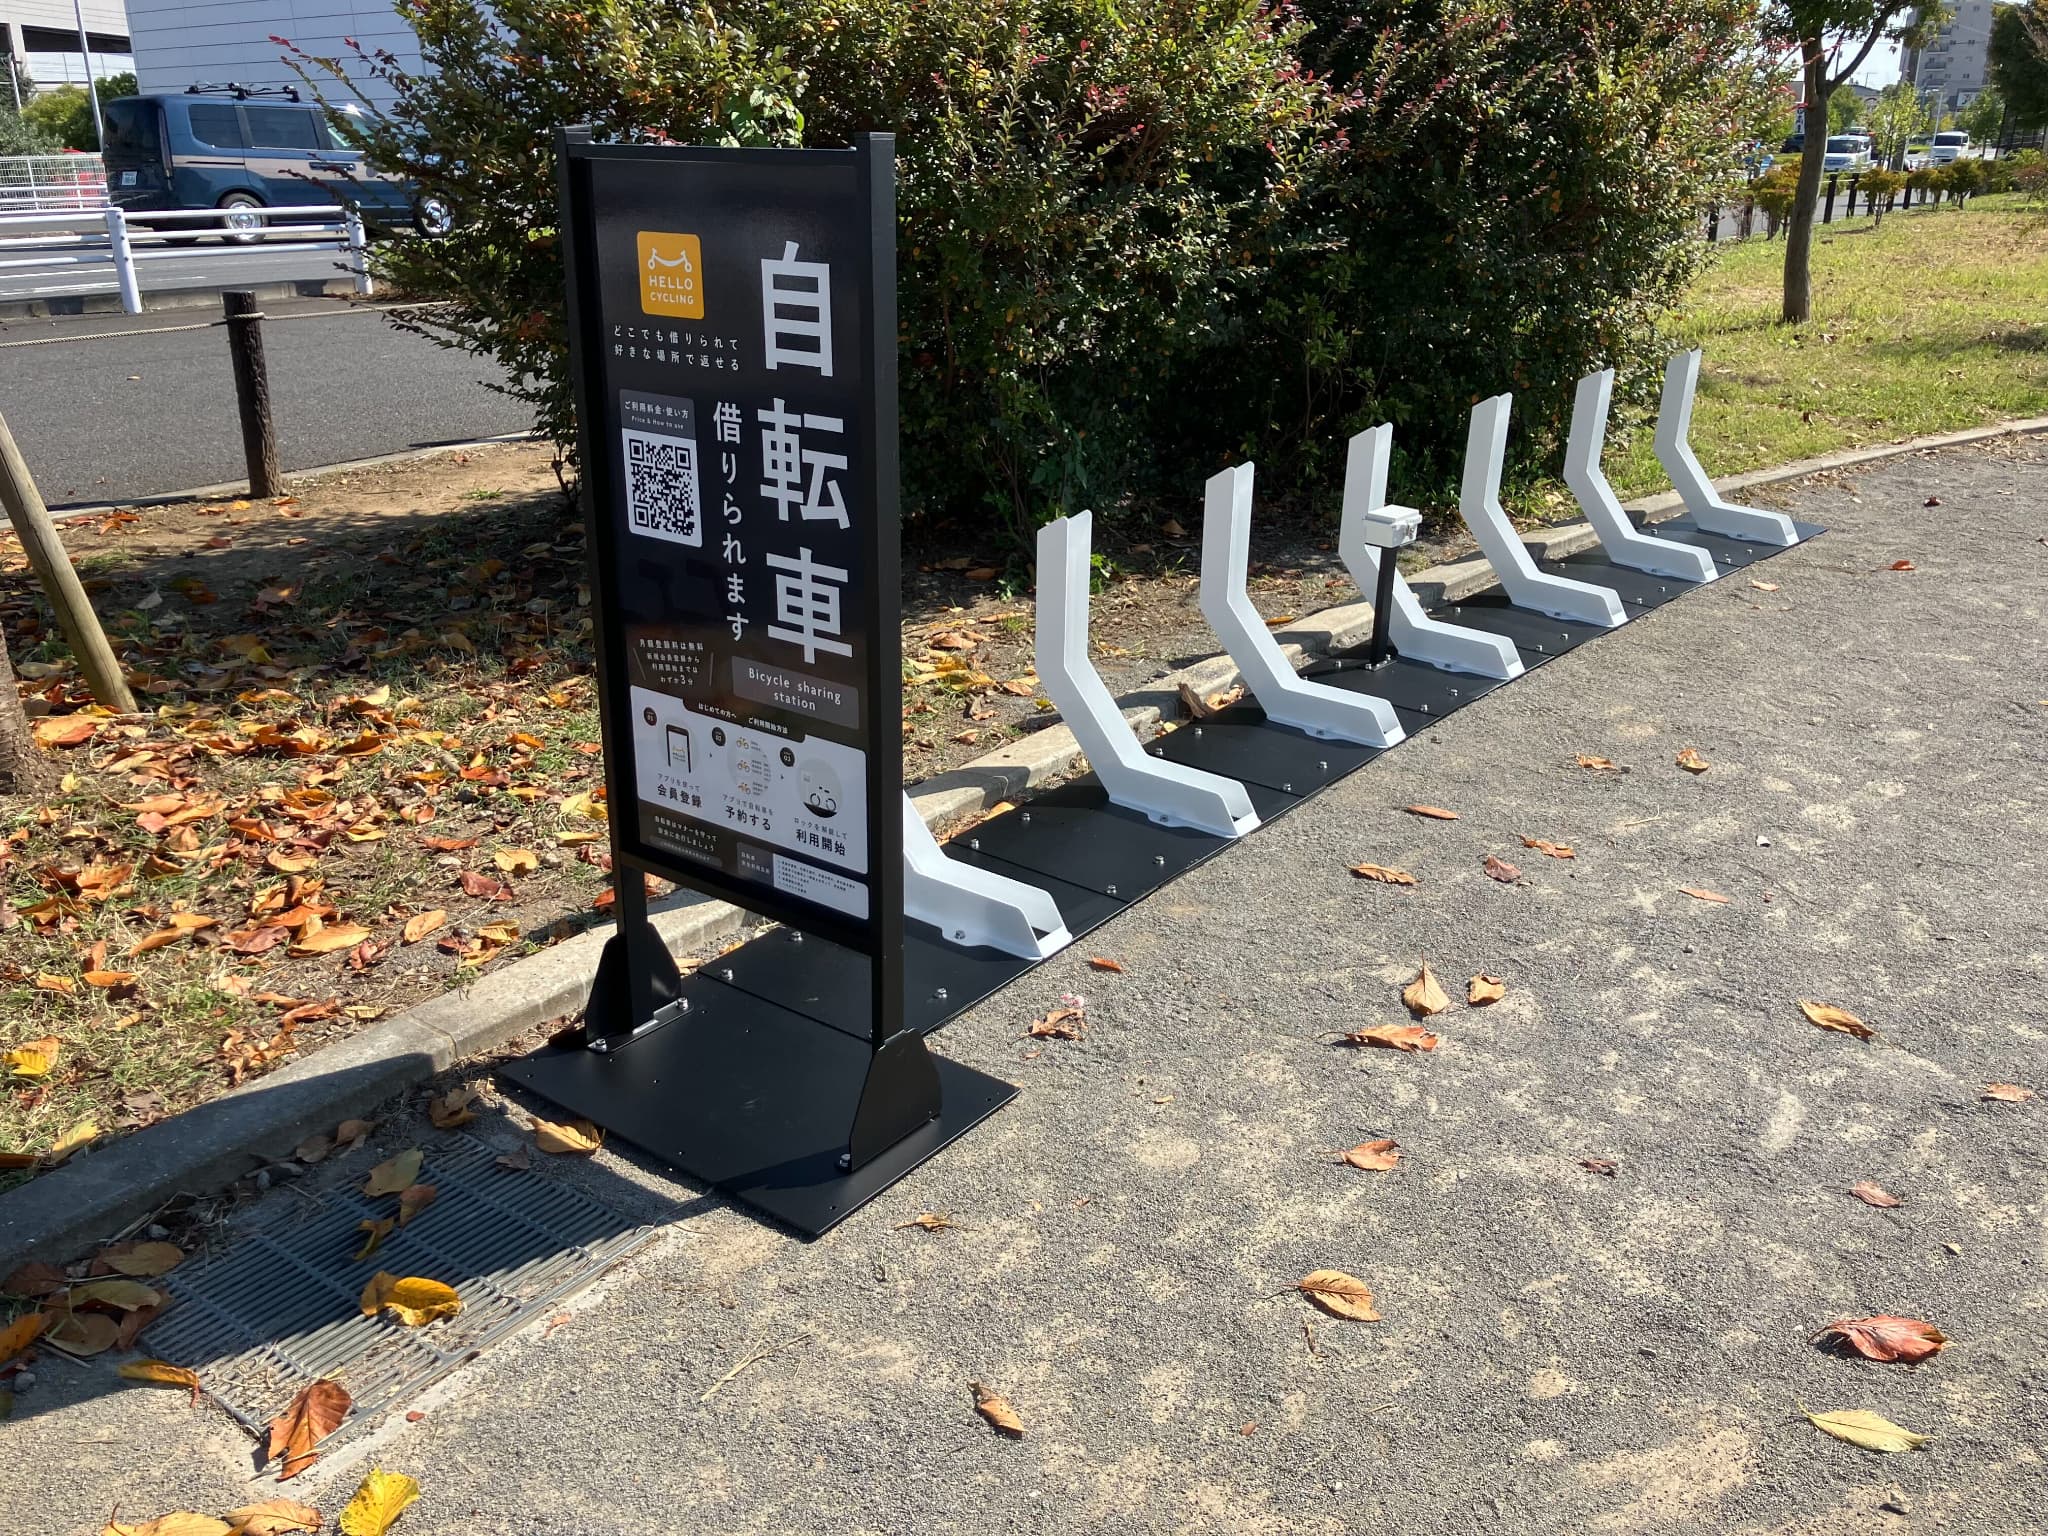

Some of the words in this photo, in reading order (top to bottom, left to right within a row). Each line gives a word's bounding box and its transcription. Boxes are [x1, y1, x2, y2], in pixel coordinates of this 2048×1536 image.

[649, 275, 693, 290] HELLO
[650, 291, 694, 305] CYCLING
[614, 324, 738, 350] どこでも借りられて
[614, 343, 739, 371] 好きな場所で返せる
[757, 240, 853, 665] 自転車
[712, 400, 749, 642] 借りられます
[748, 667, 791, 688] Bicycle
[798, 681, 841, 705] sharing
[774, 691, 816, 711] station
[657, 784, 702, 808] 会員登録
[725, 805, 771, 831] 予約する
[795, 828, 846, 856] 利用開始
